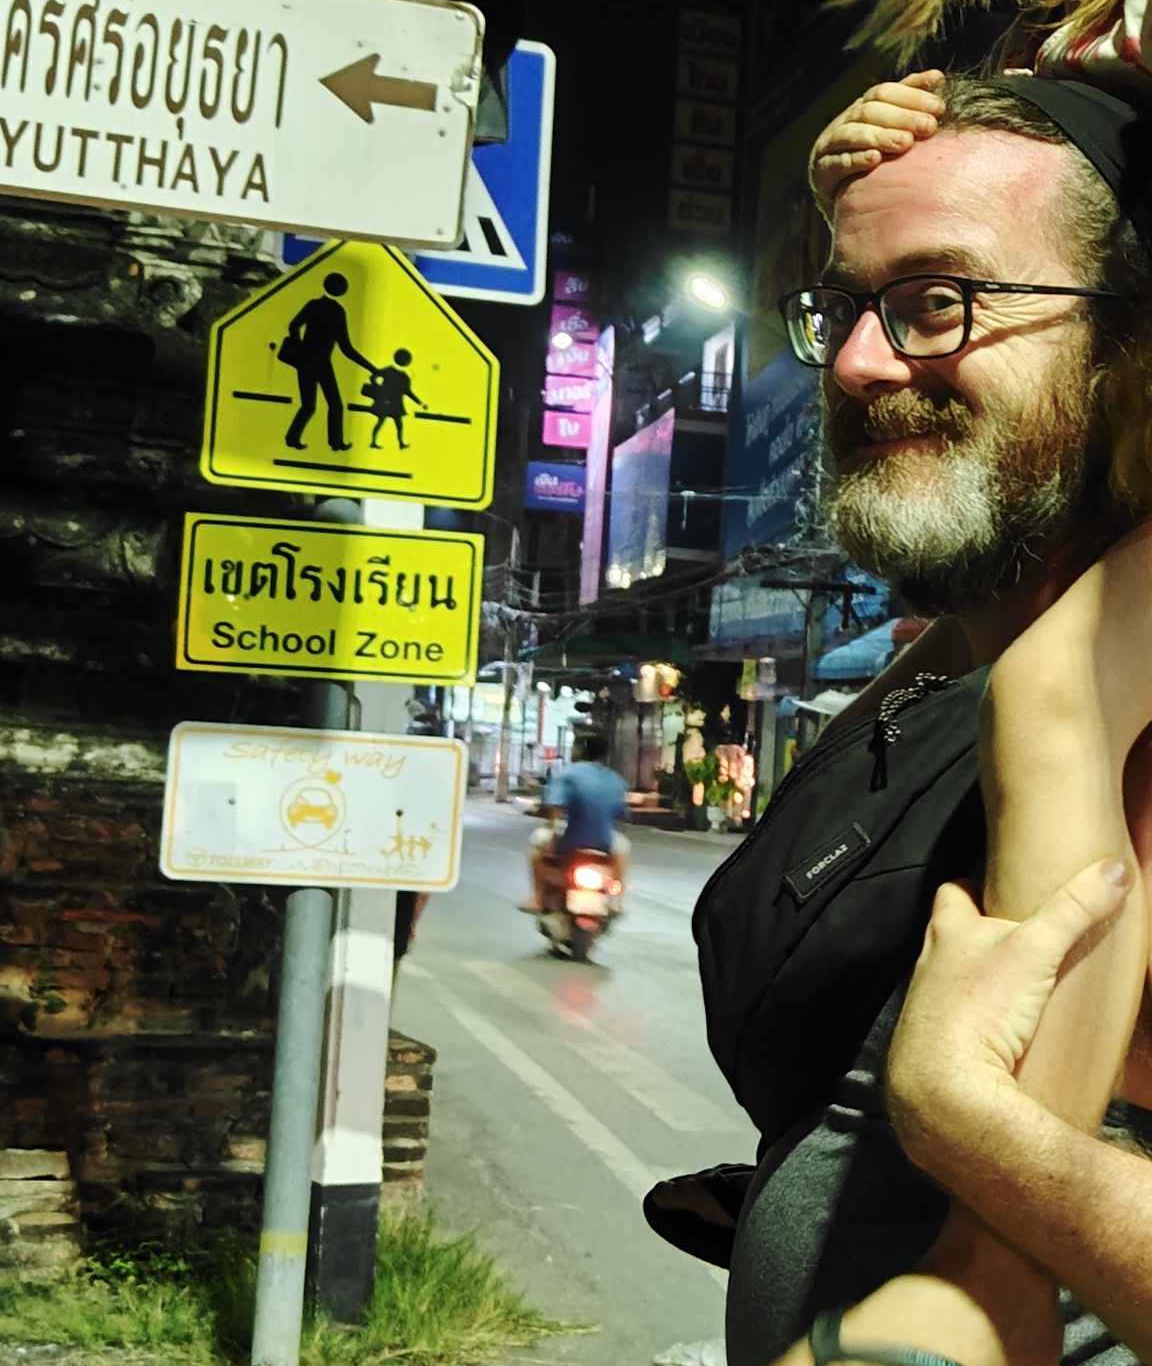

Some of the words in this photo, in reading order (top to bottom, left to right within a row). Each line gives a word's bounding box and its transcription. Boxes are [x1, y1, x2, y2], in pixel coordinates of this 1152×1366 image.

[0, 117, 271, 202] YUTTHAYA
[203, 541, 457, 611] เขตโรงเรียน
[211, 621, 336, 656] School
[355, 631, 445, 662] Zone
[344, 749, 407, 779] way
[209, 853, 274, 868] TOLLWAY
[805, 843, 849, 880] FORCLAZ
